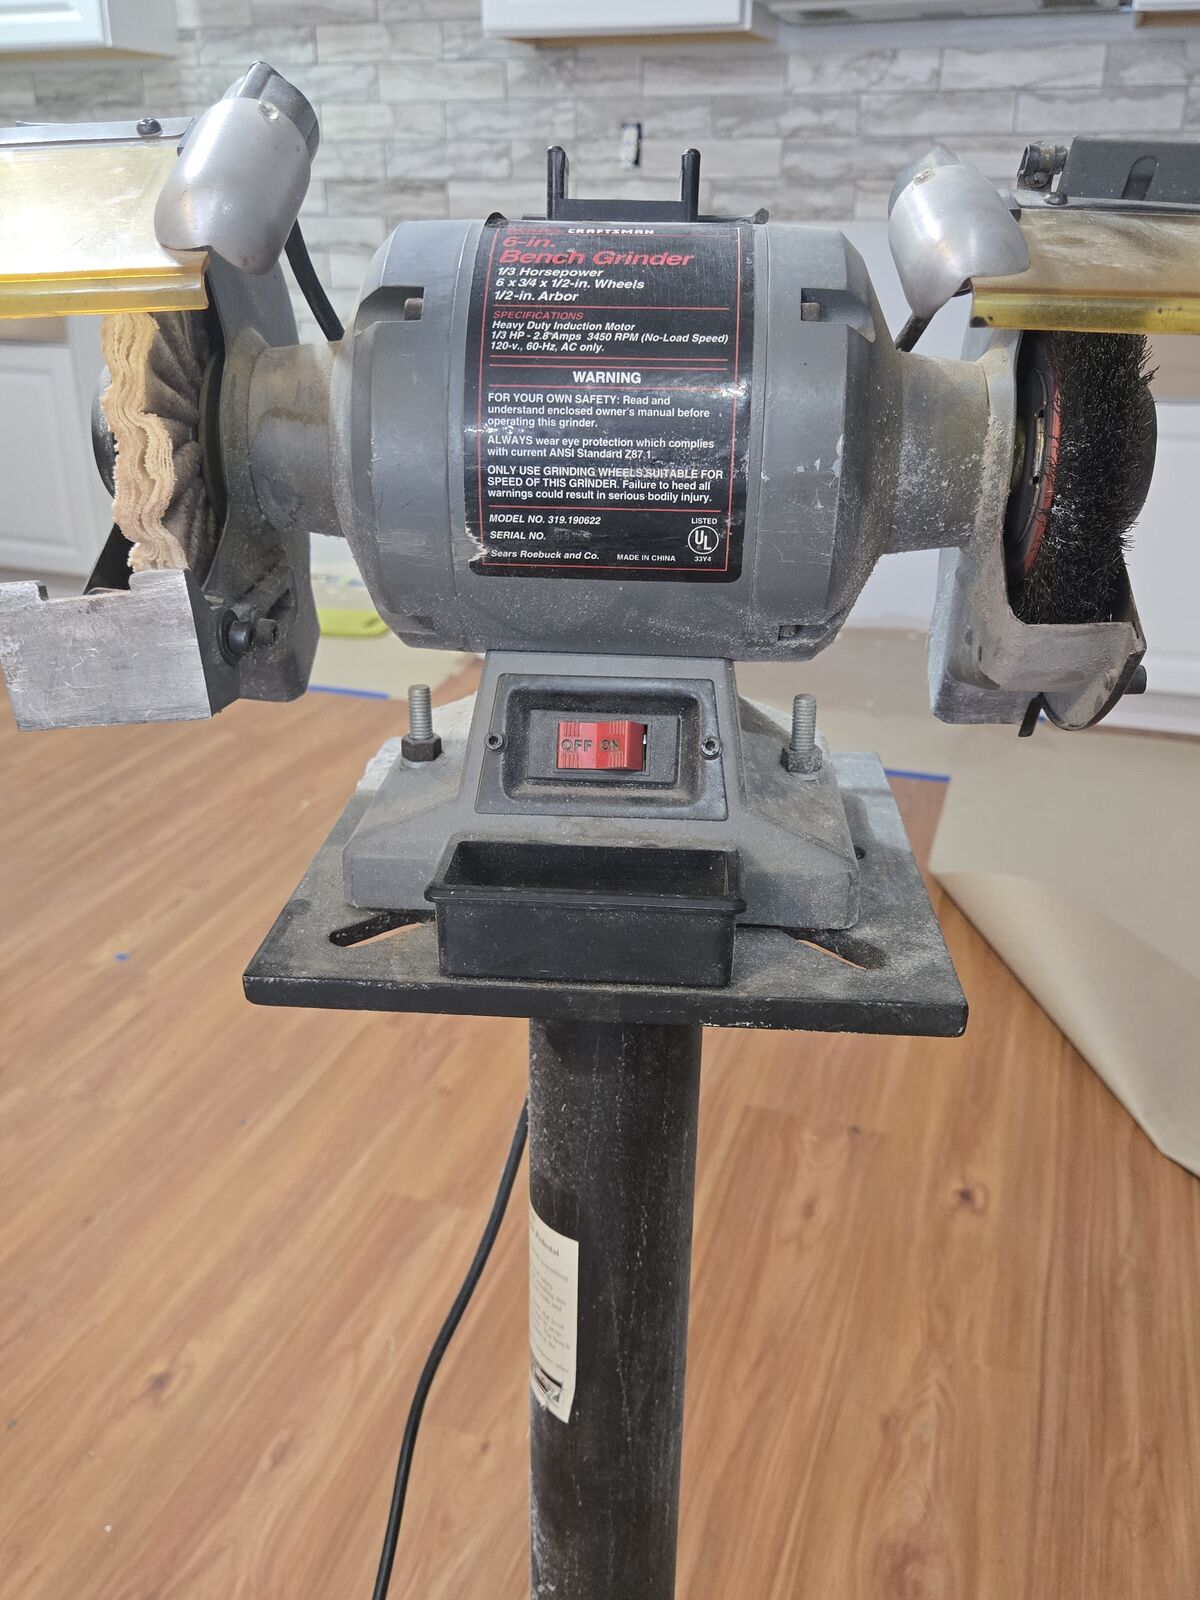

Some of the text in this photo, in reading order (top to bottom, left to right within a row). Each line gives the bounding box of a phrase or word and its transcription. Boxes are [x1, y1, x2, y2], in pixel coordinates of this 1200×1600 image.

[503, 236, 556, 248] 6-in.
[499, 249, 695, 266] Bench Grinder
[498, 267, 604, 278] 1/3 Horsepower
[496, 278, 504, 287] 6
[518, 278, 537, 288] 3/4
[539, 280, 547, 288] x
[552, 279, 590, 289] 1/2-in.
[595, 280, 645, 290] Wheels
[494, 291, 579, 301] 1/2-in. Arbor
[493, 311, 584, 320] SPECIFICATIONS
[492, 320, 635, 332] Heavy Duty Induction Motor
[491, 331, 507, 340] 1/3
[509, 331, 525, 340] HP
[533, 332, 548, 340] 2.8
[551, 332, 582, 342] Amps
[587, 332, 612, 341] 3450
[614, 333, 639, 342] RPM
[641, 333, 689, 344] (No-Load
[692, 334, 728, 344] Speed)
[491, 342, 605, 354] 120-v., 60-Hz, AC only.
[572, 371, 642, 384] WARNING
[488, 392, 670, 406] FOR YOUR OWN SAFETY: Read and
[487, 405, 710, 418] understand enclosed owner's manual before
[487, 417, 598, 429] operating this grinder.
[488, 436, 715, 450] ALWAYS wear eye protection which complies
[487, 446, 508, 456] with
[510, 448, 547, 457] current
[549, 448, 574, 458] ANSI
[577, 448, 622, 458] Standard
[488, 465, 724, 479] ONLY USE GRINDING WHEELS SUITABLE FOR
[488, 477, 710, 490] SPEED OF THIS GRINDER. Failure to heed all
[488, 488, 712, 504] warnings could result in serious bodily injury.
[489, 514, 602, 525] MODEL NO. 319.190622
[490, 530, 526, 540] SERIAL
[528, 532, 546, 540] NO.
[694, 530, 712, 550] UL
[490, 550, 518, 558] Sears
[520, 550, 561, 559] Roebuck
[584, 552, 600, 560] Co.
[652, 554, 676, 562] CHINA
[562, 738, 592, 752] OFF
[601, 740, 620, 751] ON
